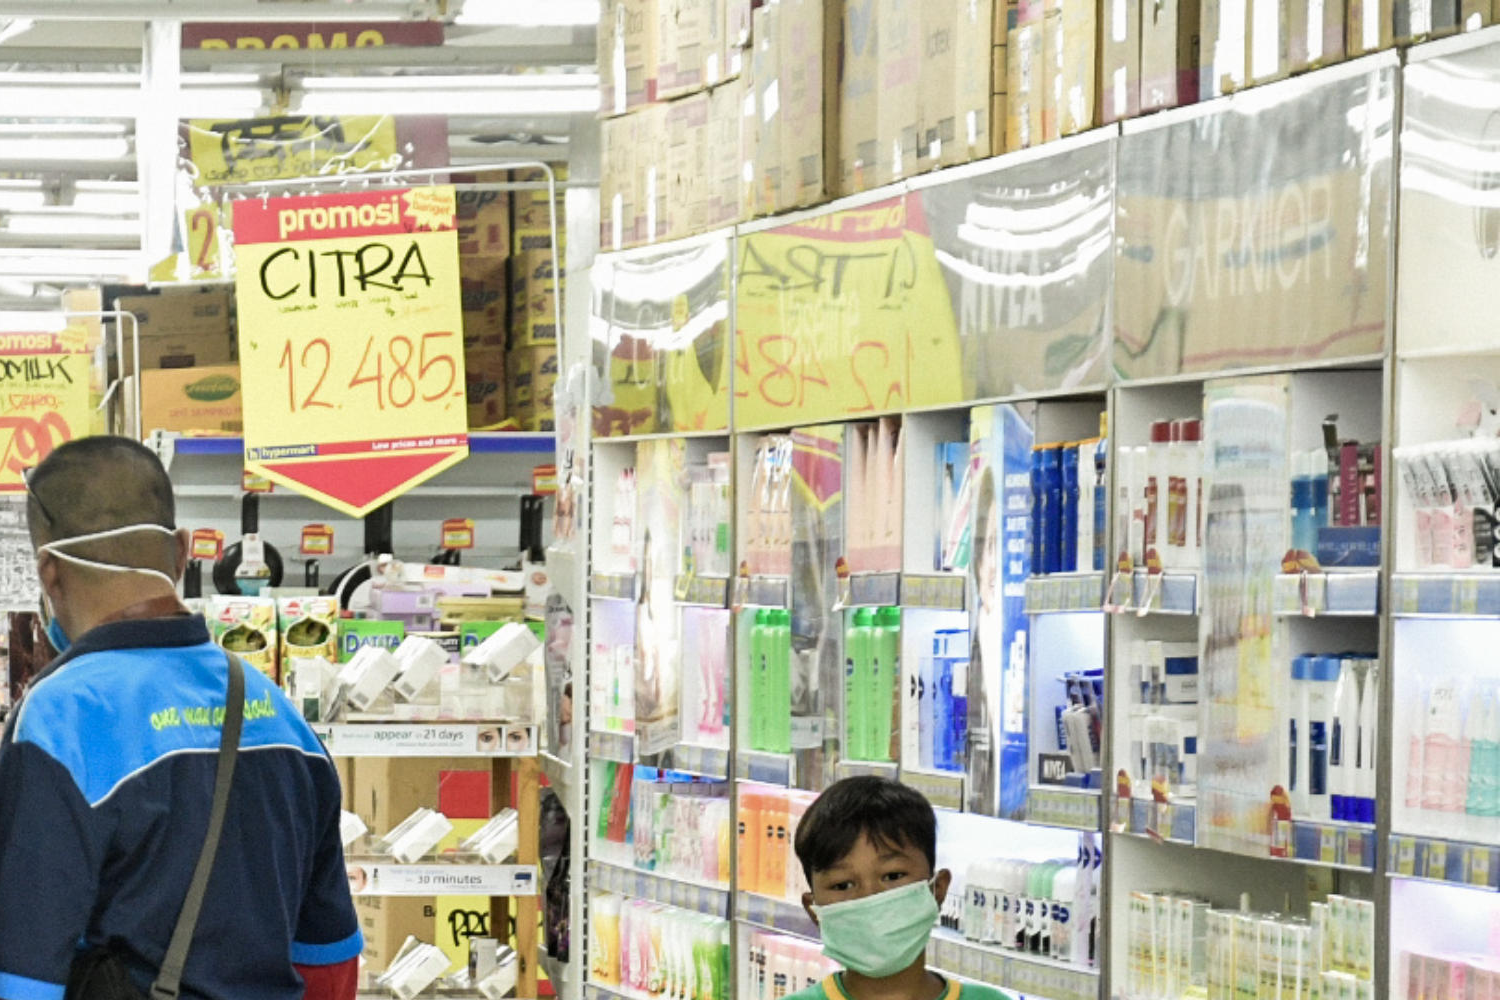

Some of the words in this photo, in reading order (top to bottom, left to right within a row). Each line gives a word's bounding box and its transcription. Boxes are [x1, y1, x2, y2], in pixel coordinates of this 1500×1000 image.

[279, 194, 401, 240] promosi
[259, 240, 435, 300] CITRA
[261, 445, 316, 459] hypermart
[374, 729, 413, 741] appear
[423, 729, 437, 740] 21
[438, 728, 464, 741] days
[417, 874, 430, 884] 30
[433, 873, 482, 885] minutes
